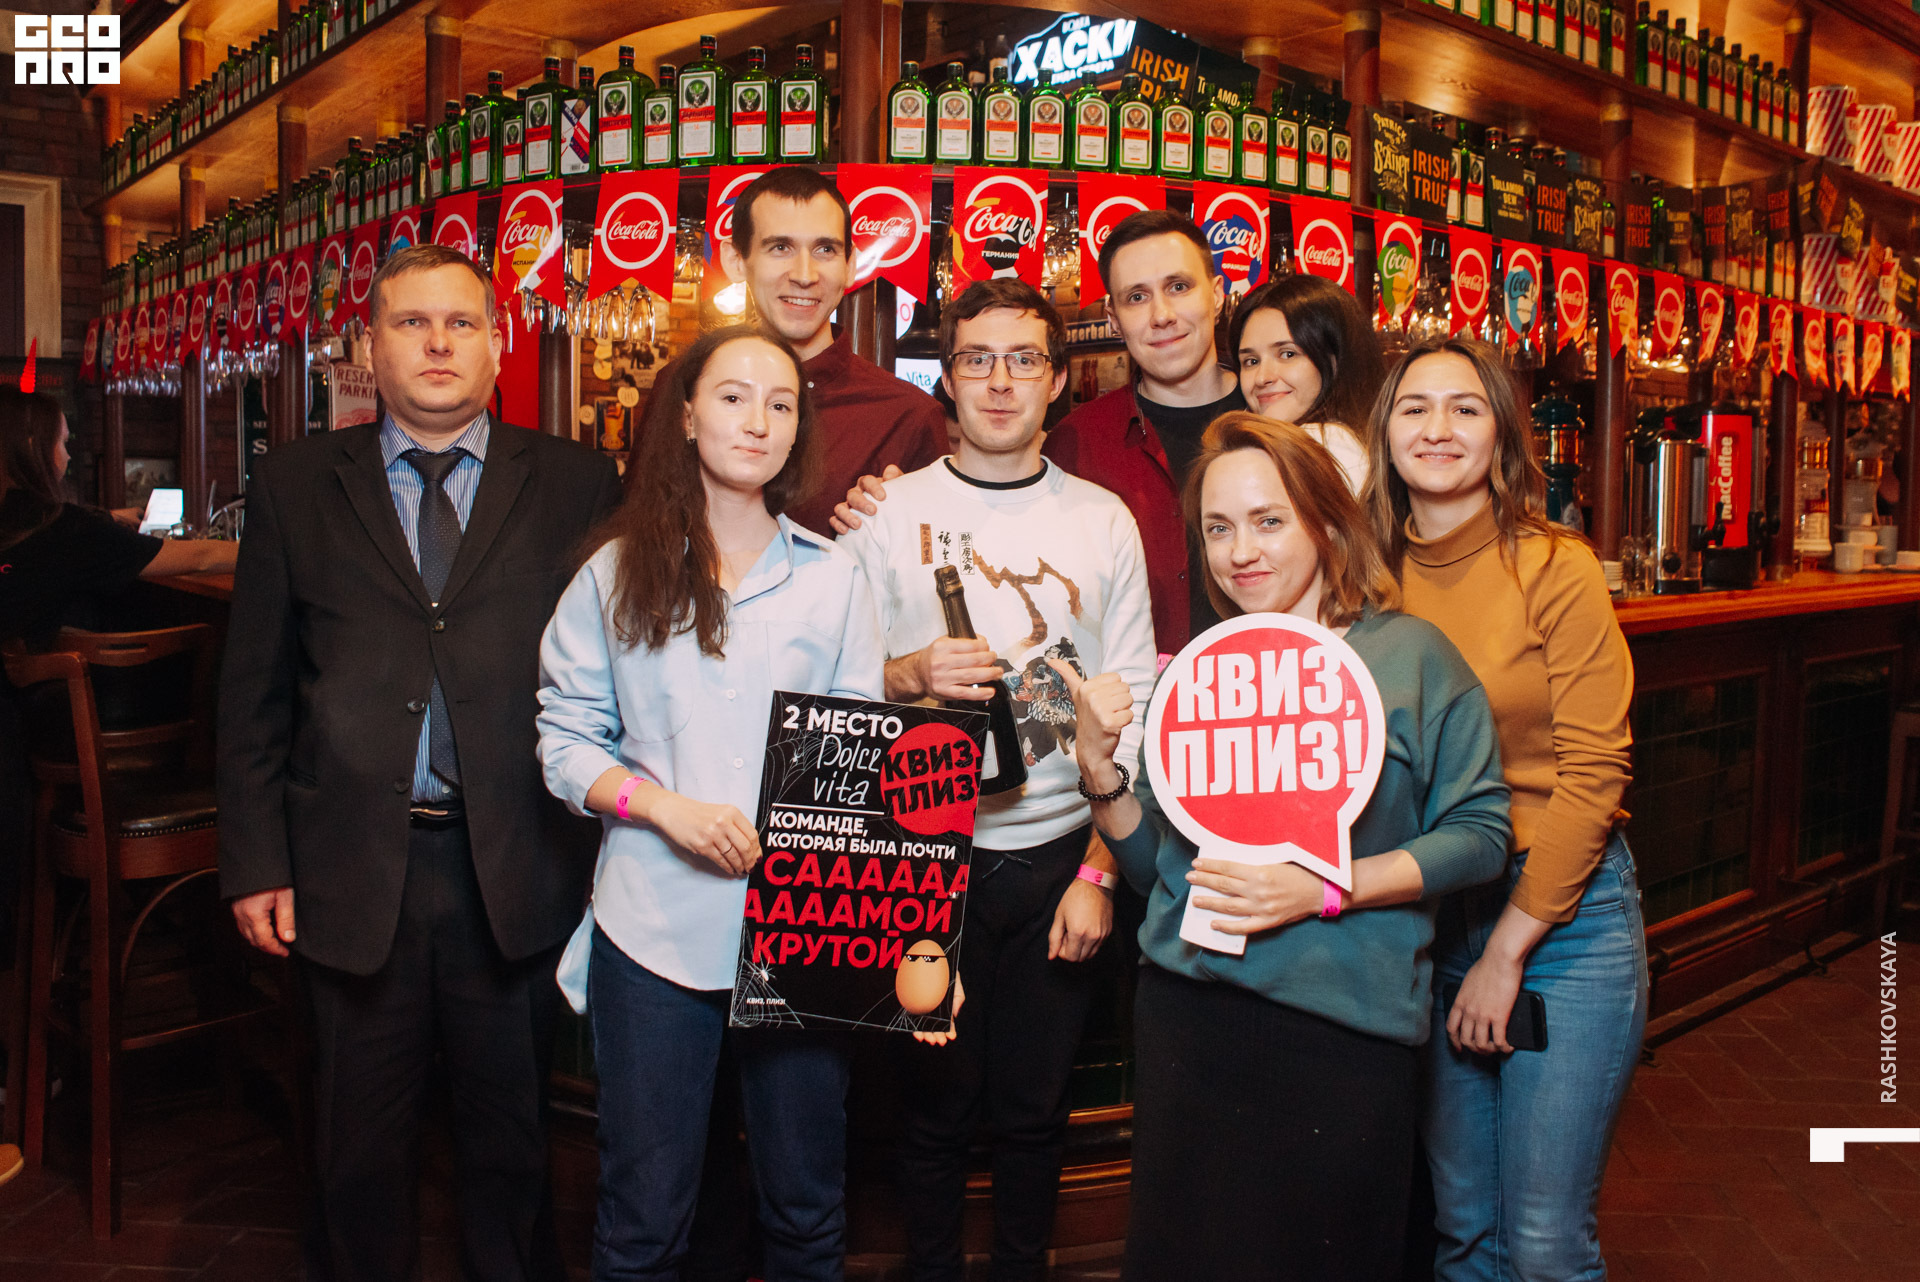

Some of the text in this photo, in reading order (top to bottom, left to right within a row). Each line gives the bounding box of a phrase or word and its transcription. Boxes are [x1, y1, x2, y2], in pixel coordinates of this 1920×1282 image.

[1131, 45, 1189, 90] IRISH
[1413, 149, 1450, 182] IRISH
[1412, 175, 1447, 208] TRUE
[1537, 184, 1567, 211] IRISH
[608, 220, 661, 240] Coca-Cola
[852, 215, 914, 238] Coca-Cola
[1536, 209, 1565, 235] TRUE
[981, 250, 1019, 260] ГЕРМАНИЯ
[1305, 245, 1342, 267] Coca-Cola
[336, 369, 374, 384] RESER
[1177, 644, 1356, 723] КВИЗ,
[783, 706, 903, 739] 2 МЕСТО
[1168, 719, 1363, 797] ПЛИЗ!
[769, 811, 868, 837] КОМАНДЕ,
[767, 832, 956, 860] КОТОРАЯ БЫЛА ПОЧТИ
[752, 930, 904, 969] КРУТОЙ
